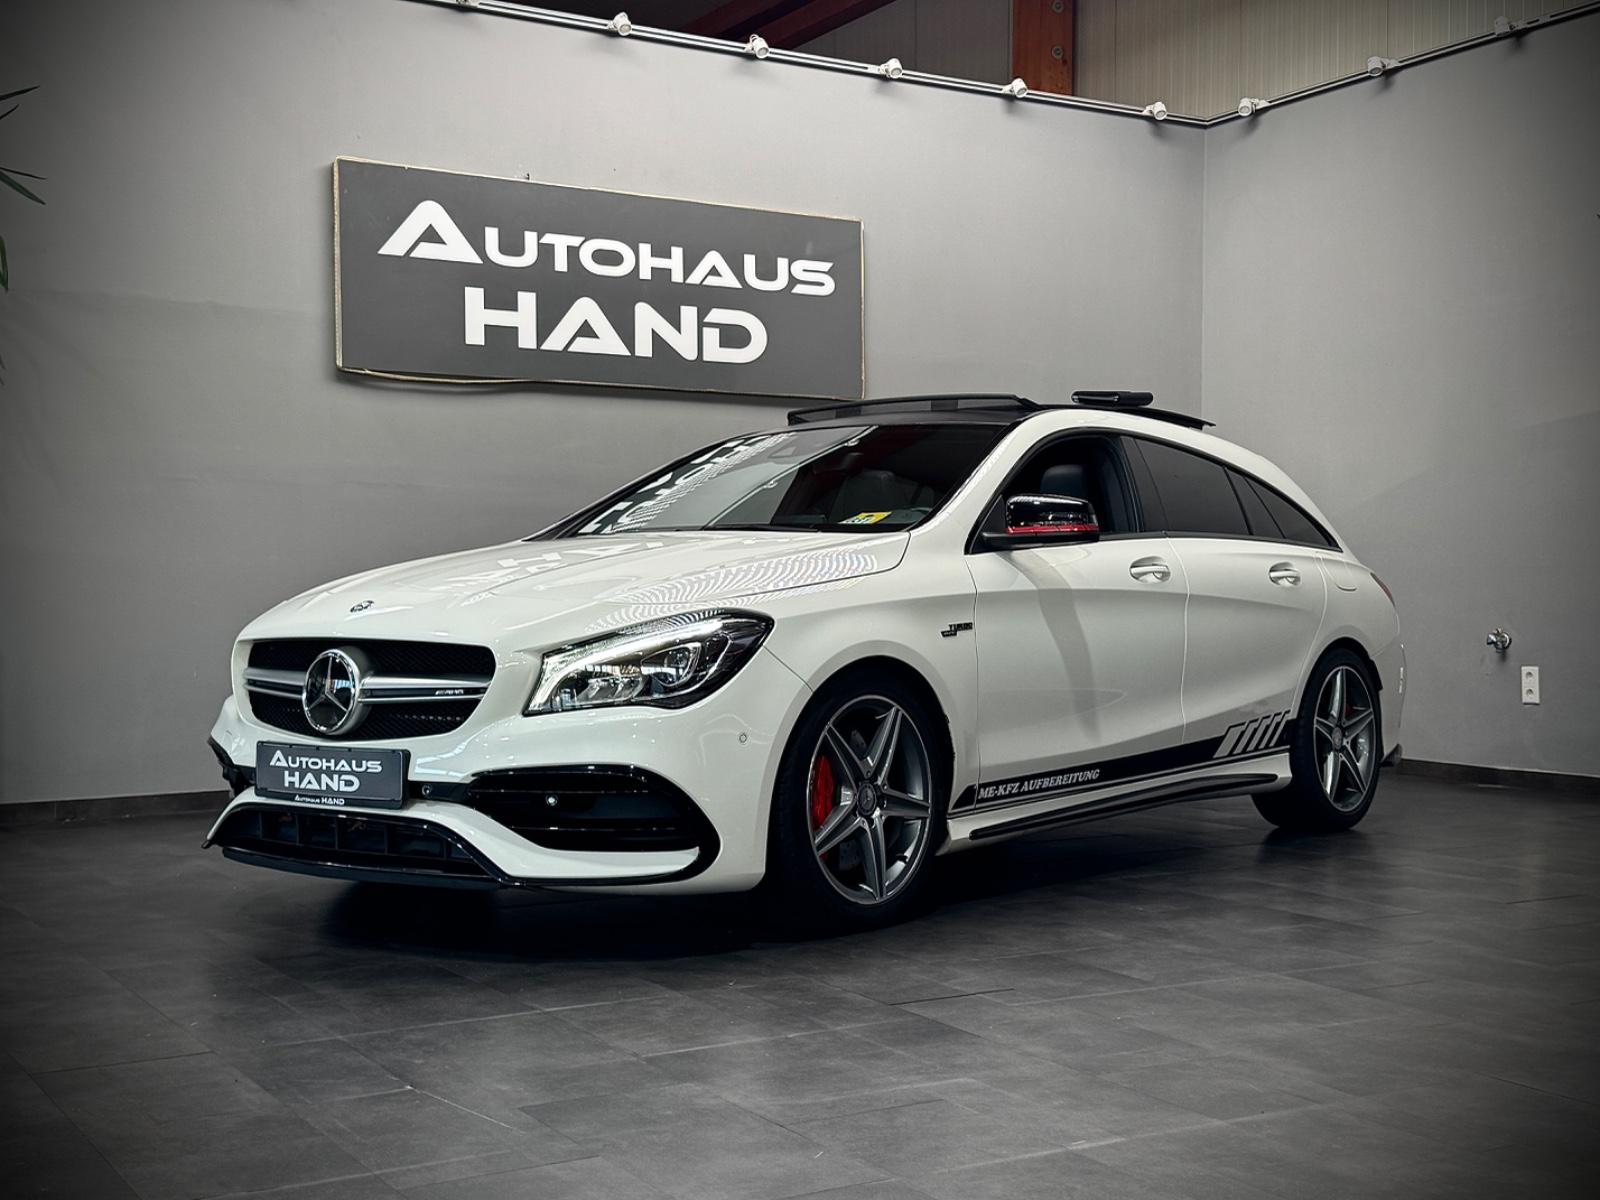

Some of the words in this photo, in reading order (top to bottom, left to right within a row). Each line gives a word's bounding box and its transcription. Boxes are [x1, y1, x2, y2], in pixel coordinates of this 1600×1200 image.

[377, 200, 836, 296] AUTOHAUS
[464, 286, 768, 364] HAND
[269, 750, 383, 773] AUTOHAUS
[284, 770, 360, 792] HAND
[1020, 769, 1100, 793] AUFBEREITUNG
[321, 797, 345, 806] HAND
